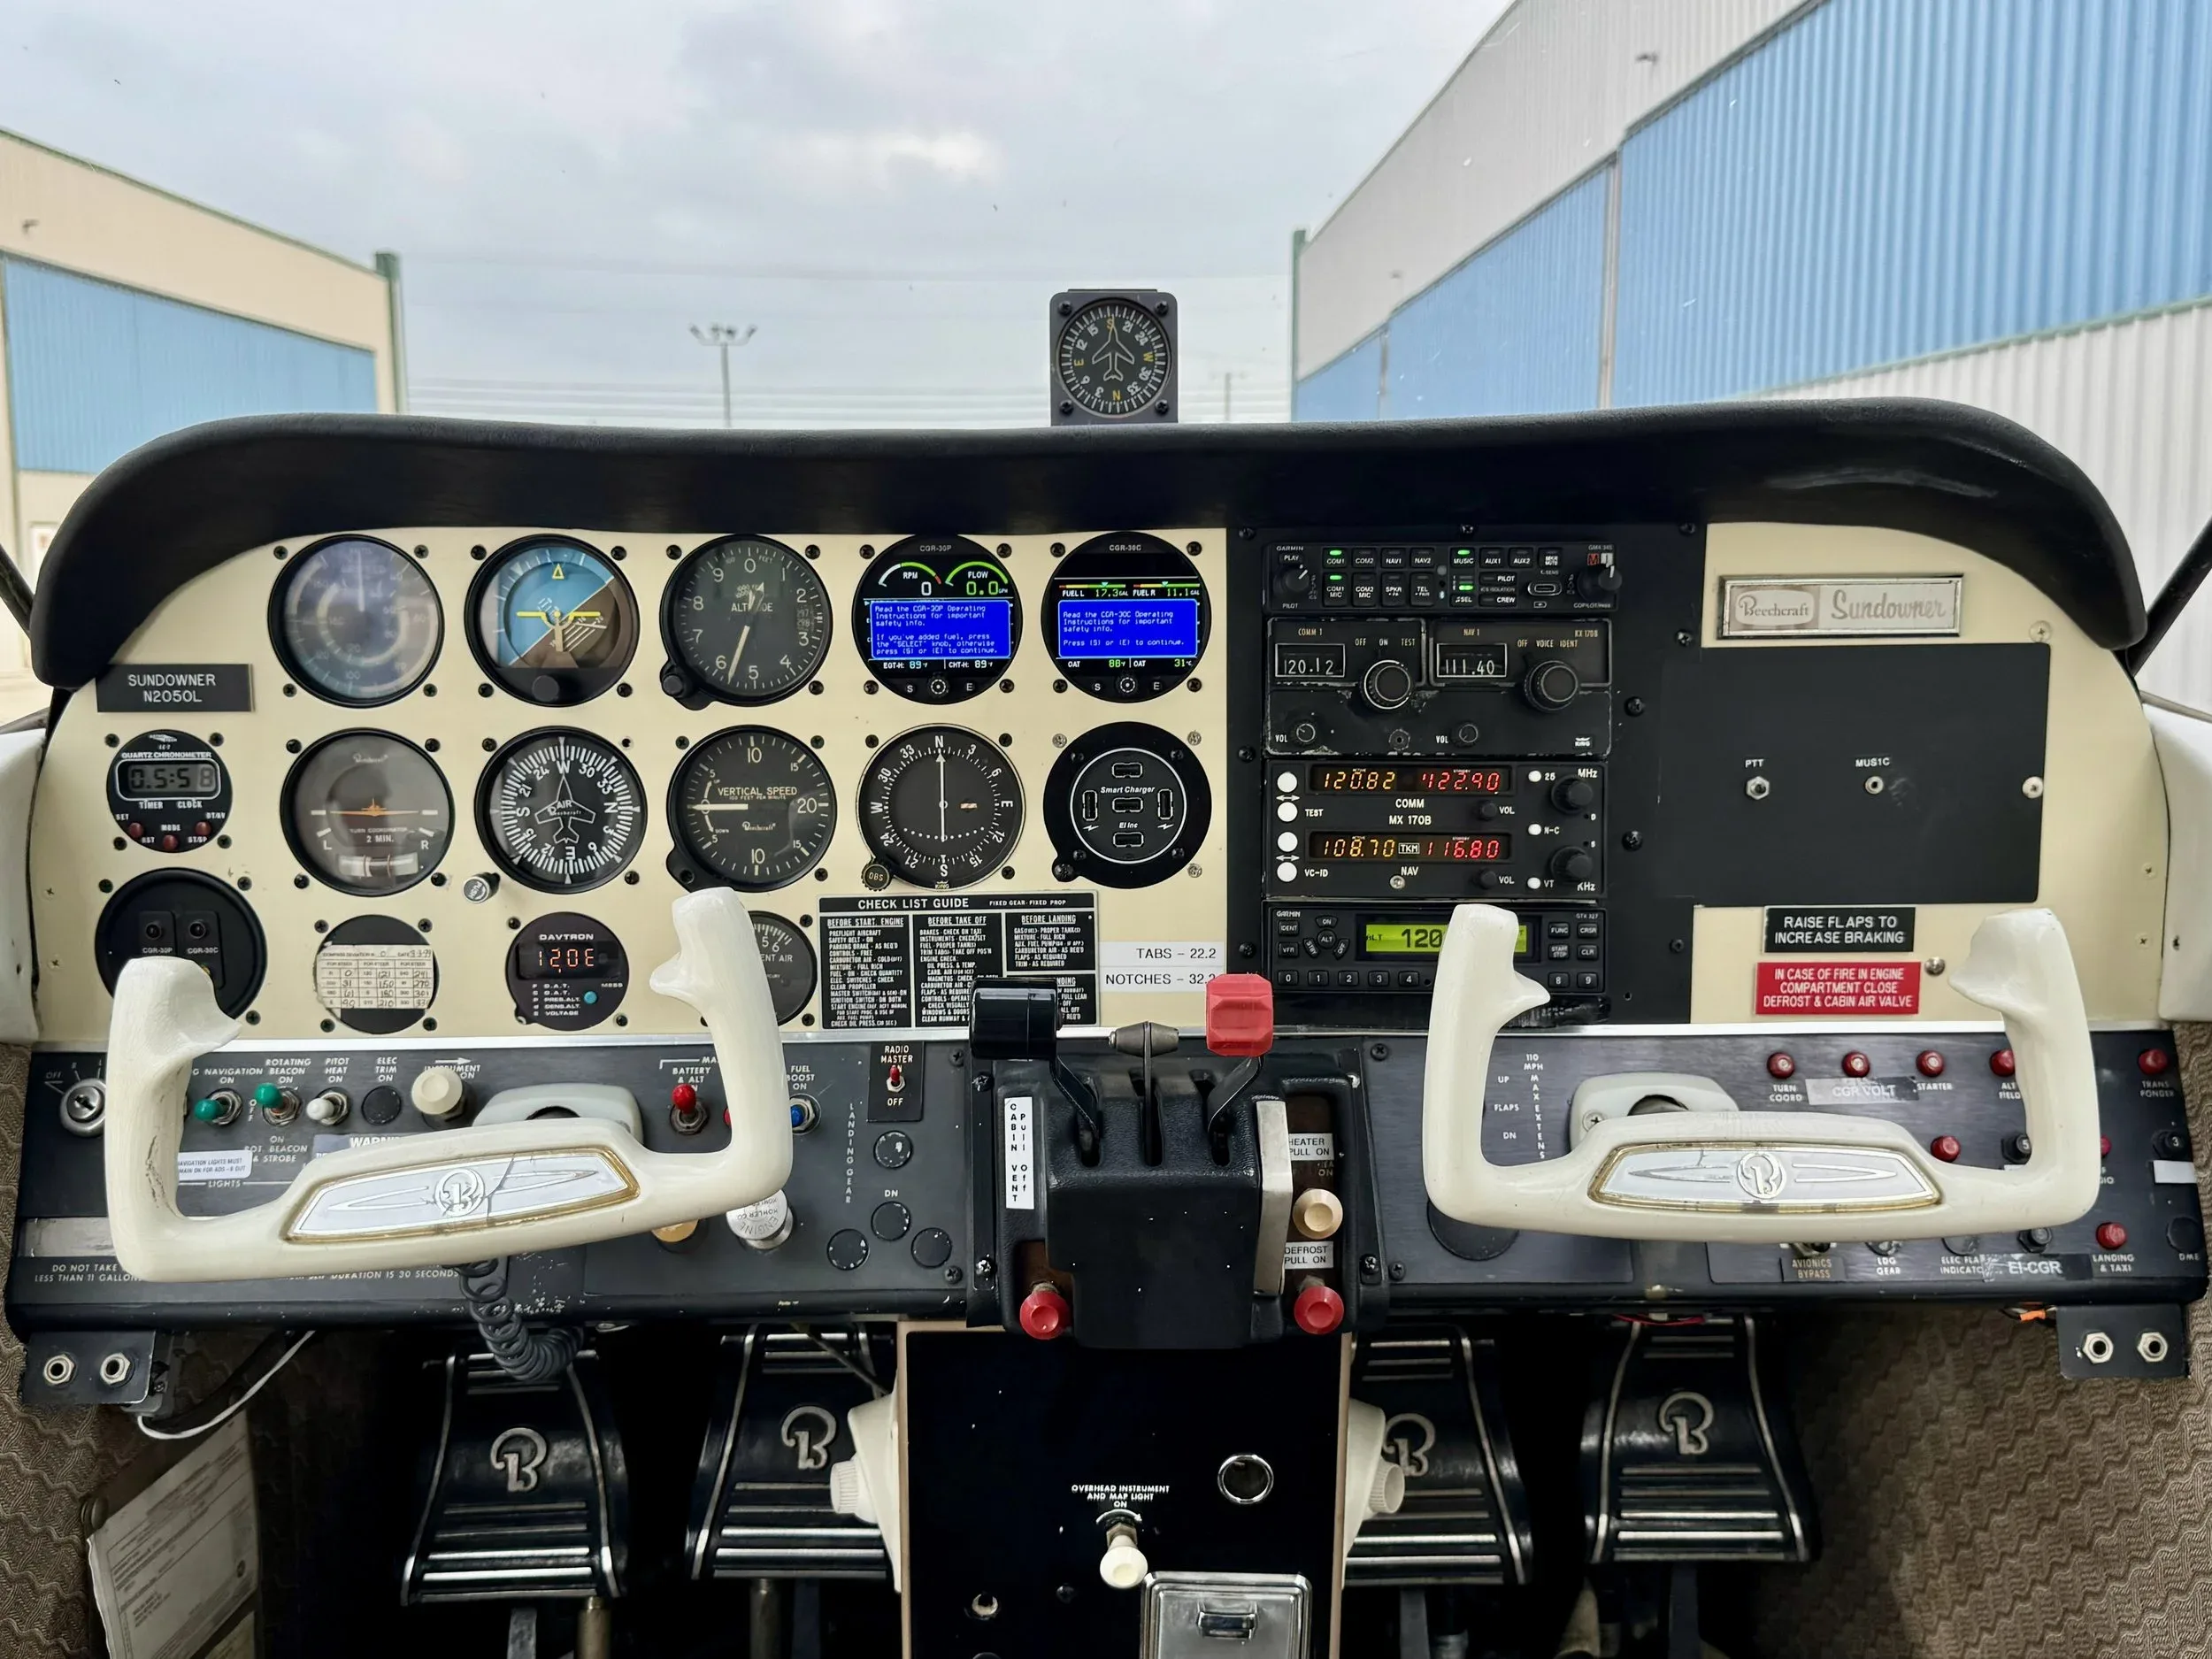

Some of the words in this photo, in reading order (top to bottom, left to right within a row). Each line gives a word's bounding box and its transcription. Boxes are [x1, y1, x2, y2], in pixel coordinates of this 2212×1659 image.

[1143, 352, 1154, 362] W
[1113, 390, 1120, 400] N
[744, 558, 756, 572] 0
[712, 568, 724, 582] 9
[921, 581, 932, 595] 0
[966, 581, 998, 595] 0.0
[1740, 595, 1809, 617] Beechcraft
[1832, 589, 1946, 619] Sundowner
[749, 665, 758, 680] 5
[1446, 659, 1494, 675] 111.40
[128, 674, 216, 686] SUNDOWNER
[143, 690, 202, 703] N2050L
[935, 736, 943, 748] N
[748, 747, 762, 763] 10
[900, 744, 914, 758] 33
[1745, 759, 1763, 768] PTT
[1578, 769, 1598, 778] MHz
[1325, 772, 1394, 789] 120.82
[767, 787, 797, 795] SPEED
[557, 800, 572, 809] AIR
[604, 802, 618, 814] N
[797, 798, 817, 813] 20
[871, 802, 883, 813] W
[1395, 799, 1425, 808] COMM
[1389, 816, 1403, 825] MX
[1409, 816, 1431, 825] 170B
[1325, 840, 1394, 856] 108.70
[1427, 841, 1499, 857] 116.80
[869, 872, 883, 881] OBS
[858, 900, 897, 910] CHECK
[902, 899, 927, 909] LIST
[933, 898, 968, 908] GUIDE
[1784, 917, 1823, 928] RAISE
[1828, 916, 1873, 927] FLAPS
[1878, 916, 1896, 927] TO
[1775, 932, 1840, 944] INCREASE
[1845, 932, 1904, 943] BRAKING
[1136, 949, 1171, 959] TABS
[1190, 949, 1216, 959] 22.2
[1106, 974, 1171, 984] NOTCHES
[1775, 969, 1784, 979] IN
[1787, 968, 1814, 979] CASE
[1817, 968, 1830, 979] OF
[1834, 968, 1855, 979] FIRE
[1858, 968, 1867, 979] IN
[1870, 968, 1904, 979] ENGINE
[1780, 982, 1859, 994] COMPARTMENT
[1863, 982, 1897, 994] CLOSE
[1763, 995, 1810, 1007] DEFROST
[1814, 995, 1821, 1007] &
[1824, 995, 1855, 1007] CABIN
[1858, 995, 1876, 1007] AIR
[1879, 995, 1911, 1007] VALVE
[1770, 1094, 1802, 1102] COORD
[2008, 1261, 2063, 1274] EI-CGR
